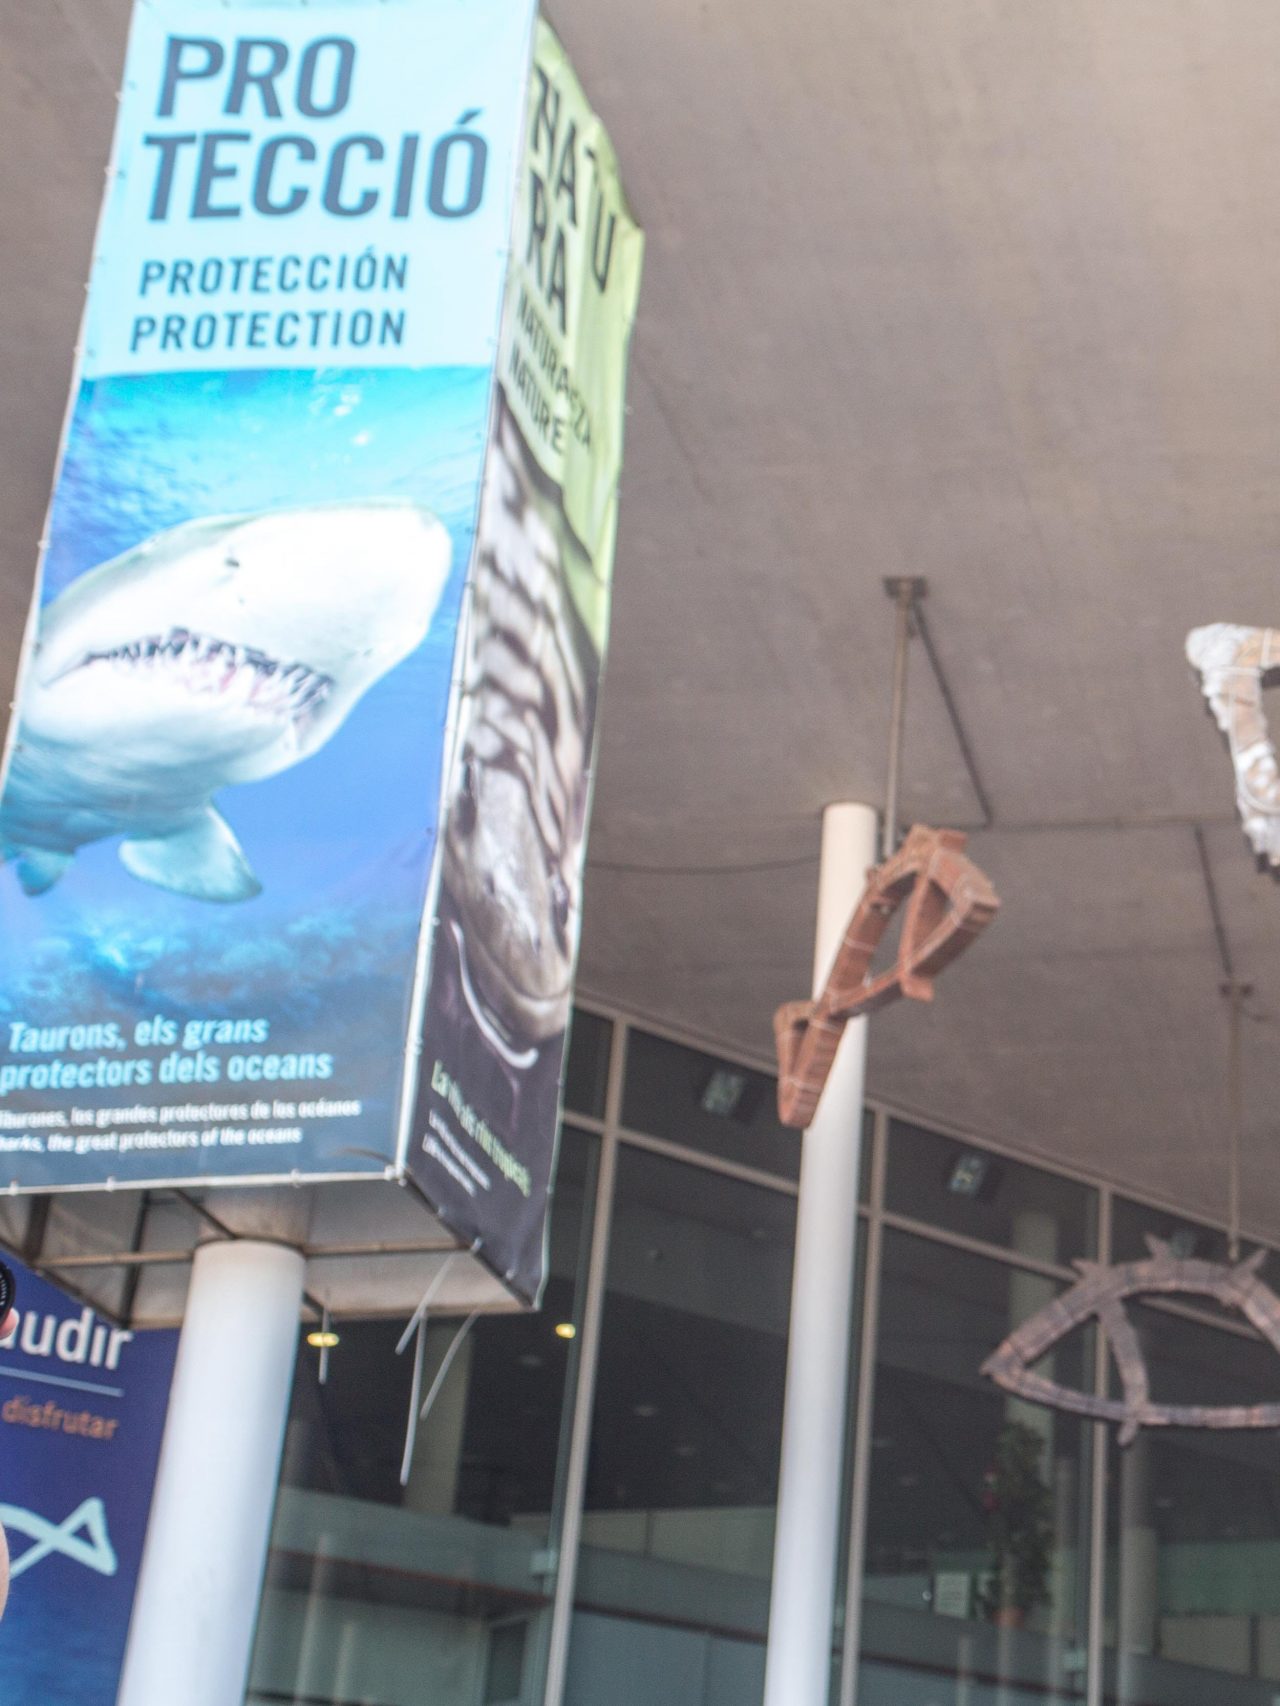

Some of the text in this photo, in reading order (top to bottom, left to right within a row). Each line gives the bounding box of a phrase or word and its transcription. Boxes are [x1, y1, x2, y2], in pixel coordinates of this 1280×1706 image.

[156, 35, 355, 119] PRO
[143, 108, 488, 221] TECCIÓ
[139, 246, 409, 296] PROTECCIÓN
[527, 167, 568, 336] RA
[130, 310, 406, 352] PROTECTION
[8, 1014, 270, 1052] Taurons, els grans
[0, 1050, 334, 1097] protectors dels oceans
[96, 1103, 158, 1128] grandes
[159, 1101, 249, 1126] protectores
[47, 1133, 74, 1152] the
[75, 1131, 118, 1155] great
[119, 1129, 199, 1153] protectors
[200, 1127, 220, 1147] of
[220, 1127, 247, 1146] the
[247, 1126, 304, 1145] oceans
[2, 1395, 119, 1440] disfrutar
